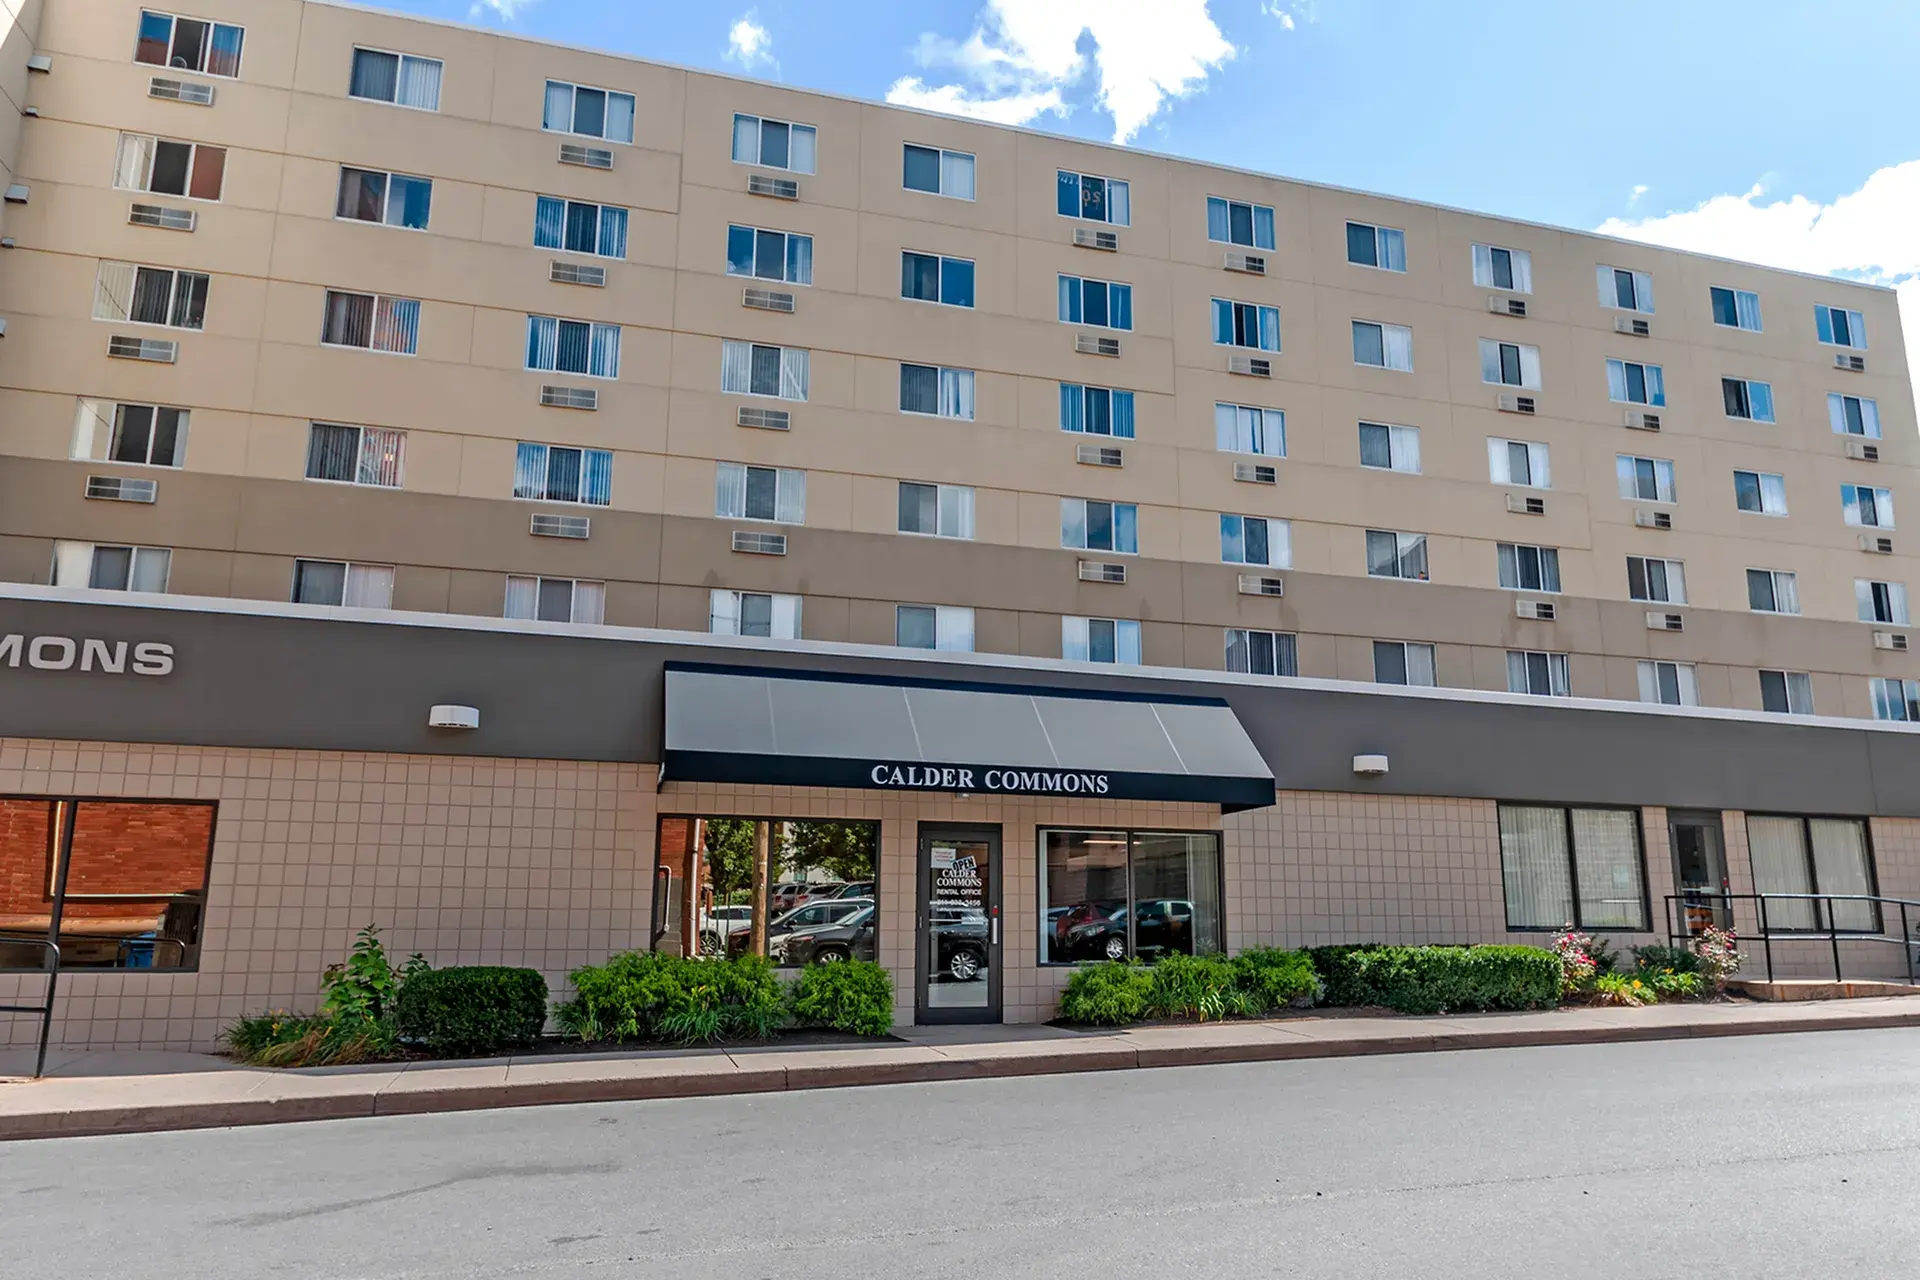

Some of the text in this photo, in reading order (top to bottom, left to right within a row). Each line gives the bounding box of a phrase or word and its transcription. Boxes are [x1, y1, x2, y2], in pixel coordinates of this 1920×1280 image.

[871, 764, 1109, 794] CALDER COMMONS
[952, 857, 975, 871] OPEN
[942, 869, 977, 878] CALDER
[936, 877, 983, 887] COMMONS
[960, 888, 982, 896] OFFICE
